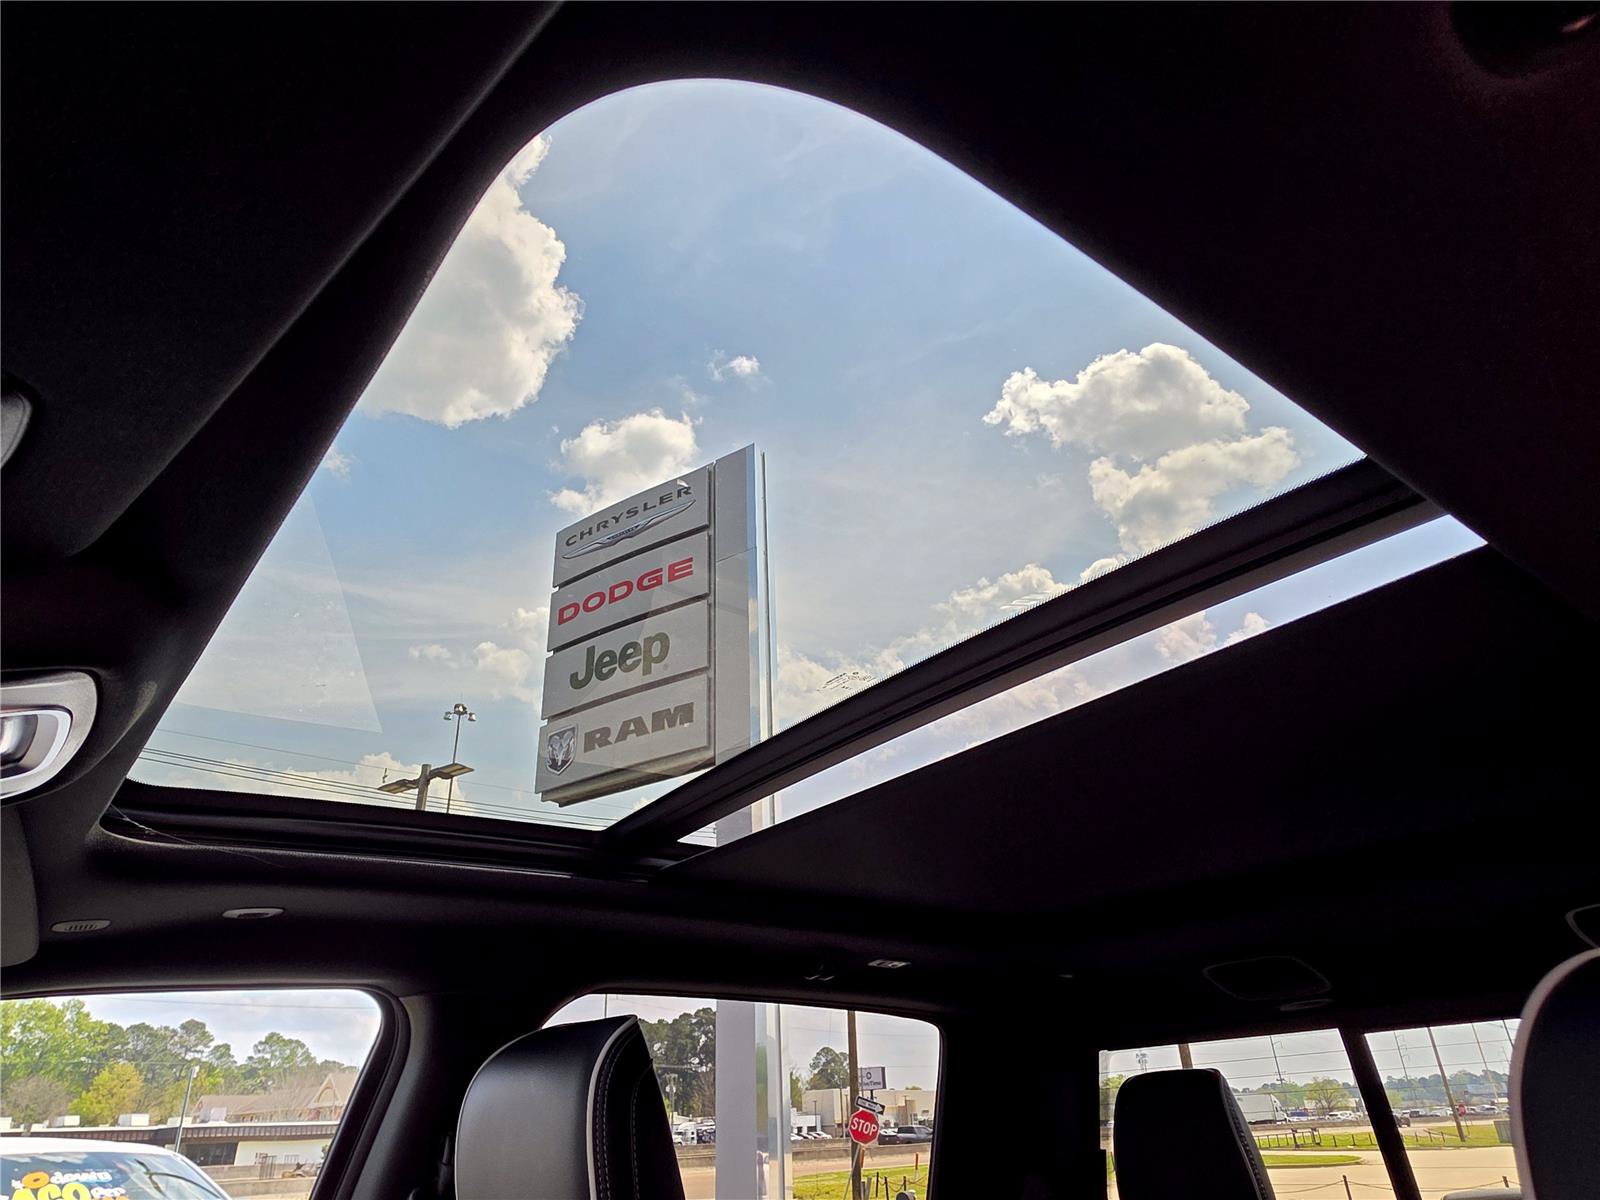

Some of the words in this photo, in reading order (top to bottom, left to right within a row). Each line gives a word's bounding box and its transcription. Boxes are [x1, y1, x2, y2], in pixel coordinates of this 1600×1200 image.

[565, 486, 692, 547] CHRYSLER
[557, 557, 694, 625] DODGE
[569, 631, 670, 690] Jeep
[583, 702, 694, 754] RAM
[851, 1117, 878, 1136] STOP
